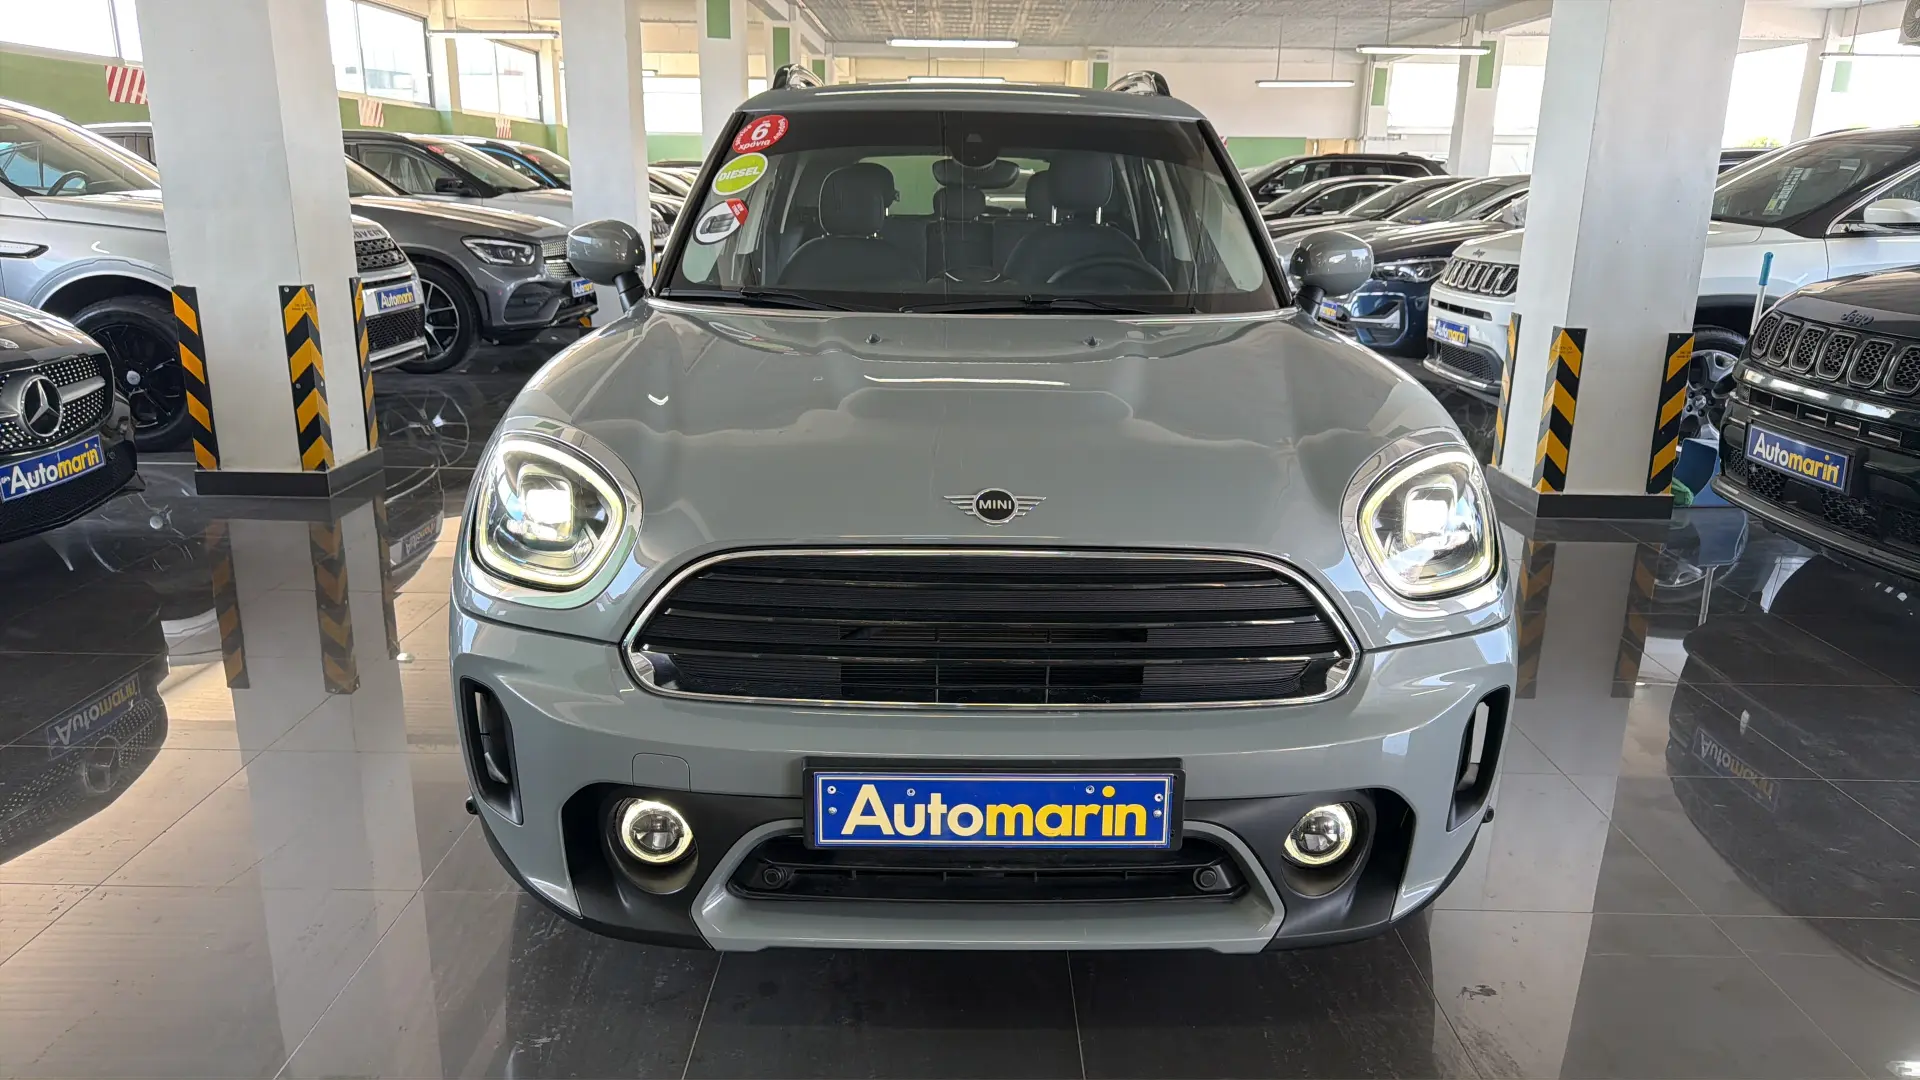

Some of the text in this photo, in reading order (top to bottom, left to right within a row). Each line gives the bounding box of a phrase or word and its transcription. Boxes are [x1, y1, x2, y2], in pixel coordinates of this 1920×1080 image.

[751, 123, 771, 141] 6
[738, 139, 771, 150] χρόνια
[717, 167, 760, 181] DIESEL
[1841, 310, 1874, 326] Jeep
[1753, 432, 1839, 484] Automarin
[11, 442, 99, 494] Automarin
[979, 500, 1012, 510] MINI
[841, 783, 1147, 837] Automarin
